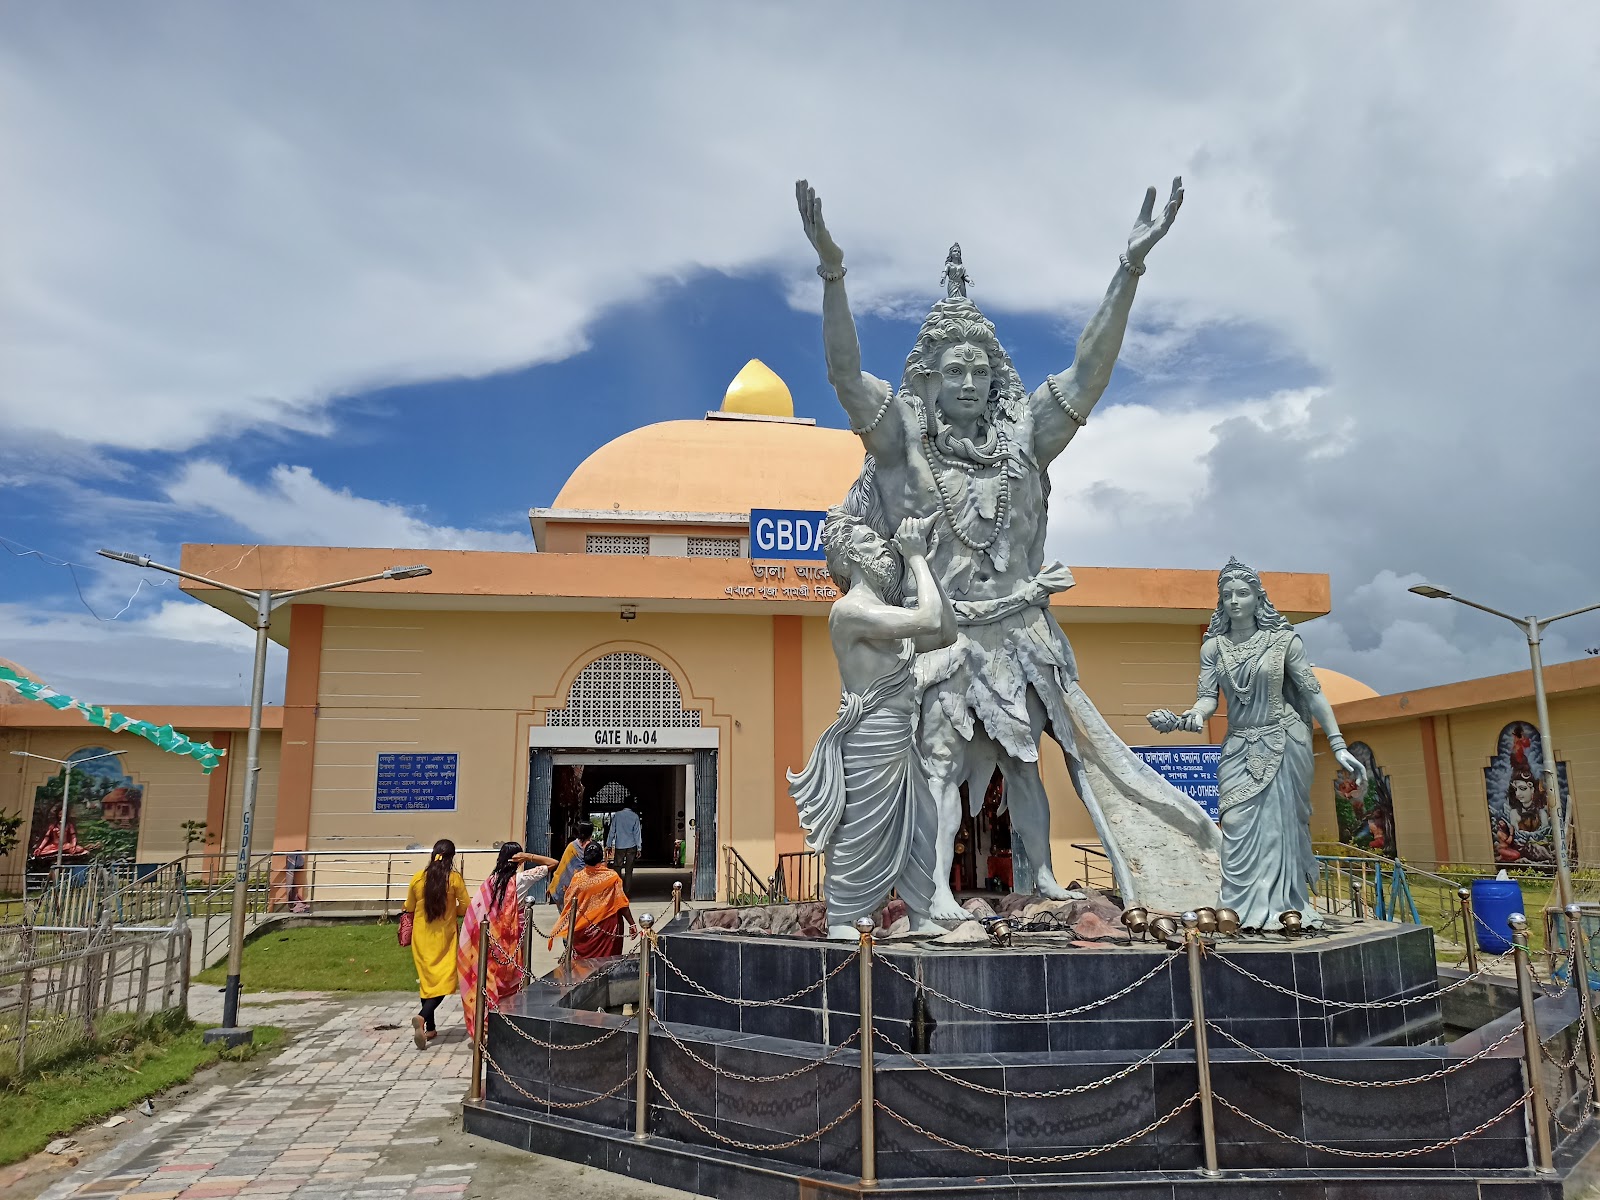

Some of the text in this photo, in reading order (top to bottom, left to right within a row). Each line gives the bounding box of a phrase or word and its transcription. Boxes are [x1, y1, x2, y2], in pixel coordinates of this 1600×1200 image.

[756, 518, 825, 551] GBDA
[752, 564, 786, 580] ডালা
[724, 584, 837, 599] এখানে পূজা সামগ্রী বিক্রি
[594, 730, 657, 745] GATE No-04
[1197, 785, 1220, 797] OTHERS
